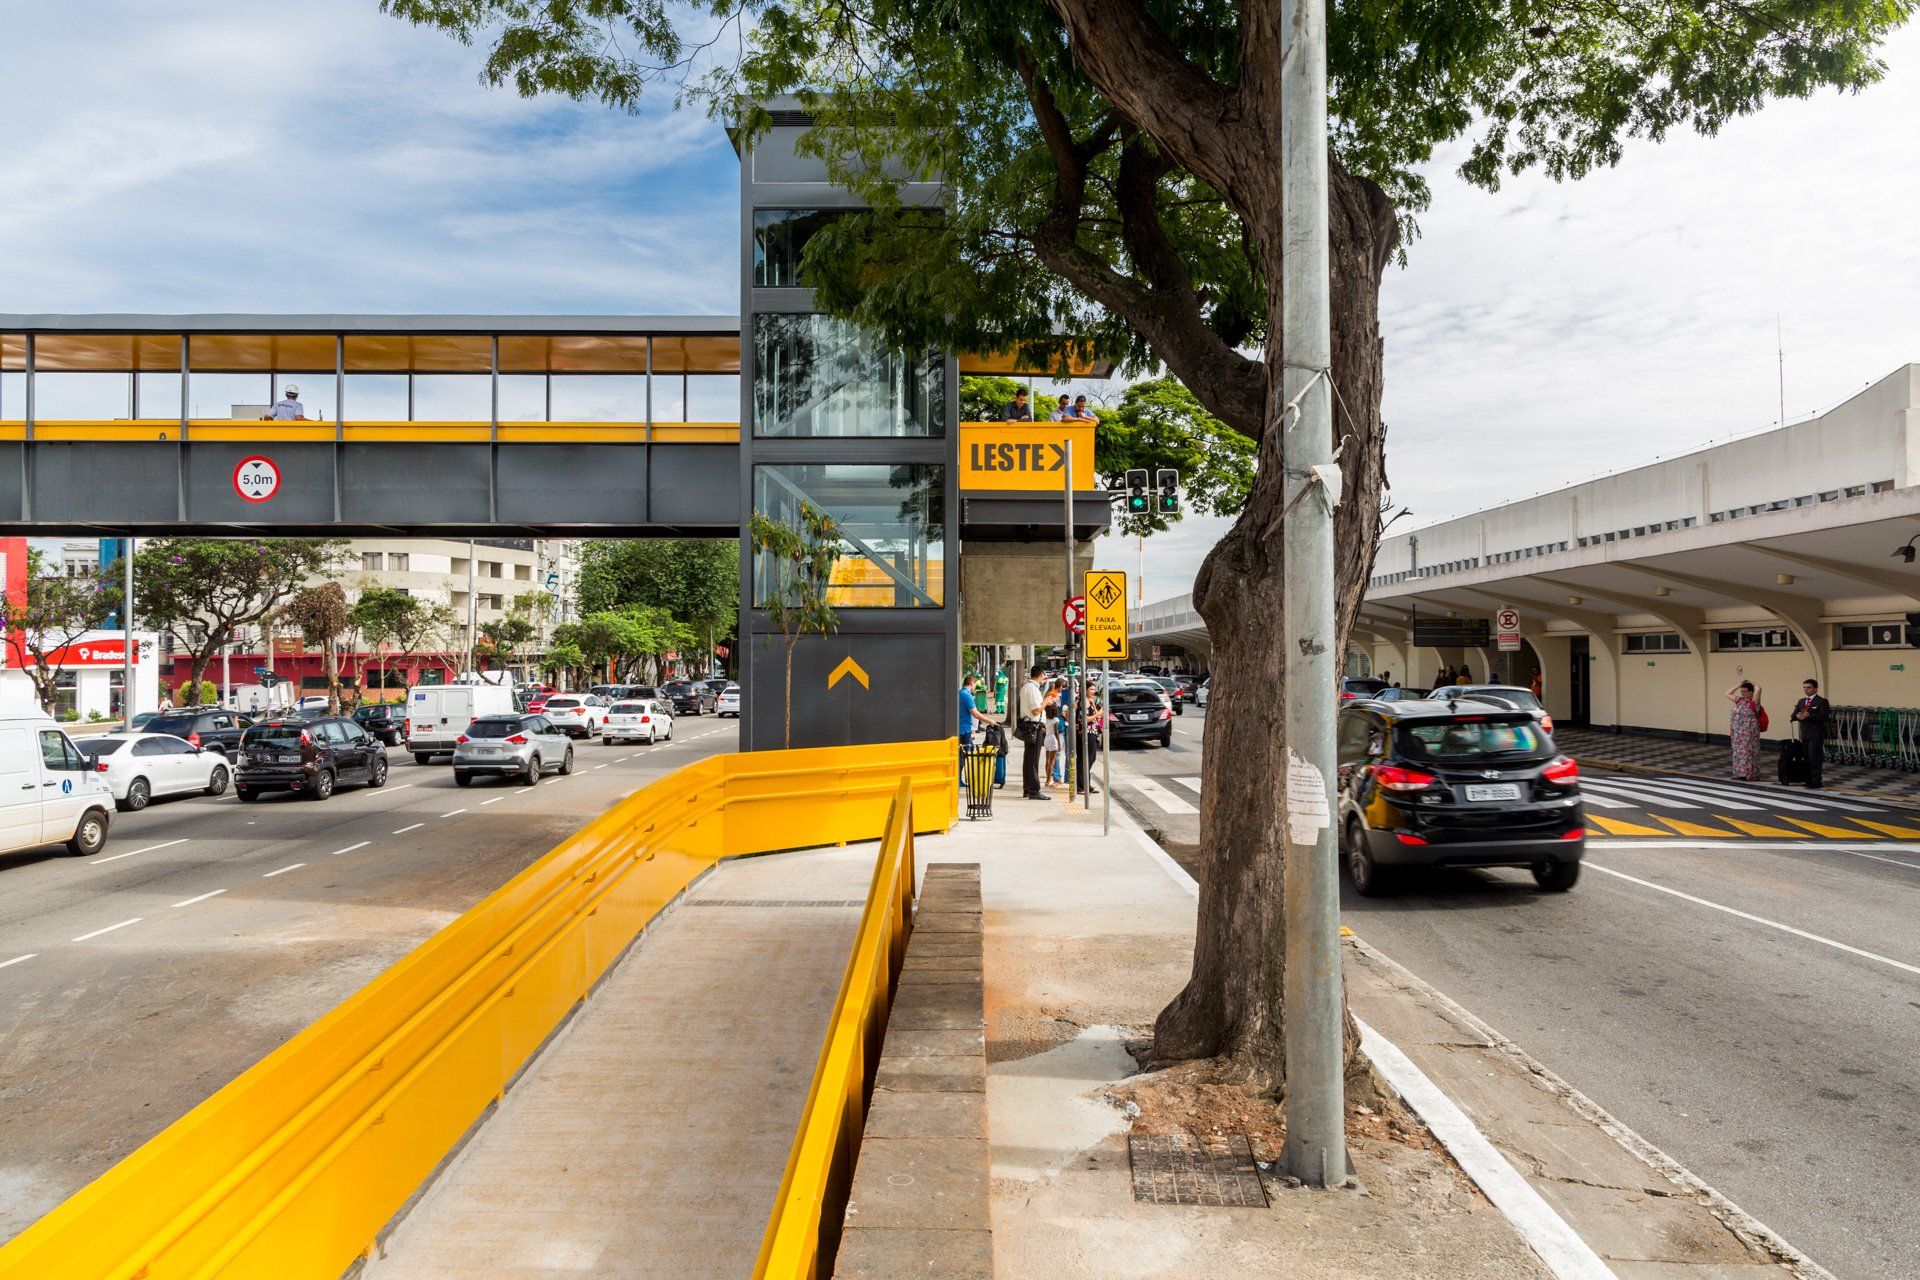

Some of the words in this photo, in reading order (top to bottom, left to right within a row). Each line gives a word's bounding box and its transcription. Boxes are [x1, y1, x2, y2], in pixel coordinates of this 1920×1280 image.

[971, 443, 1044, 471] LESTE
[243, 474, 273, 486] 5,0m
[92, 650, 126, 660] Bradesc
